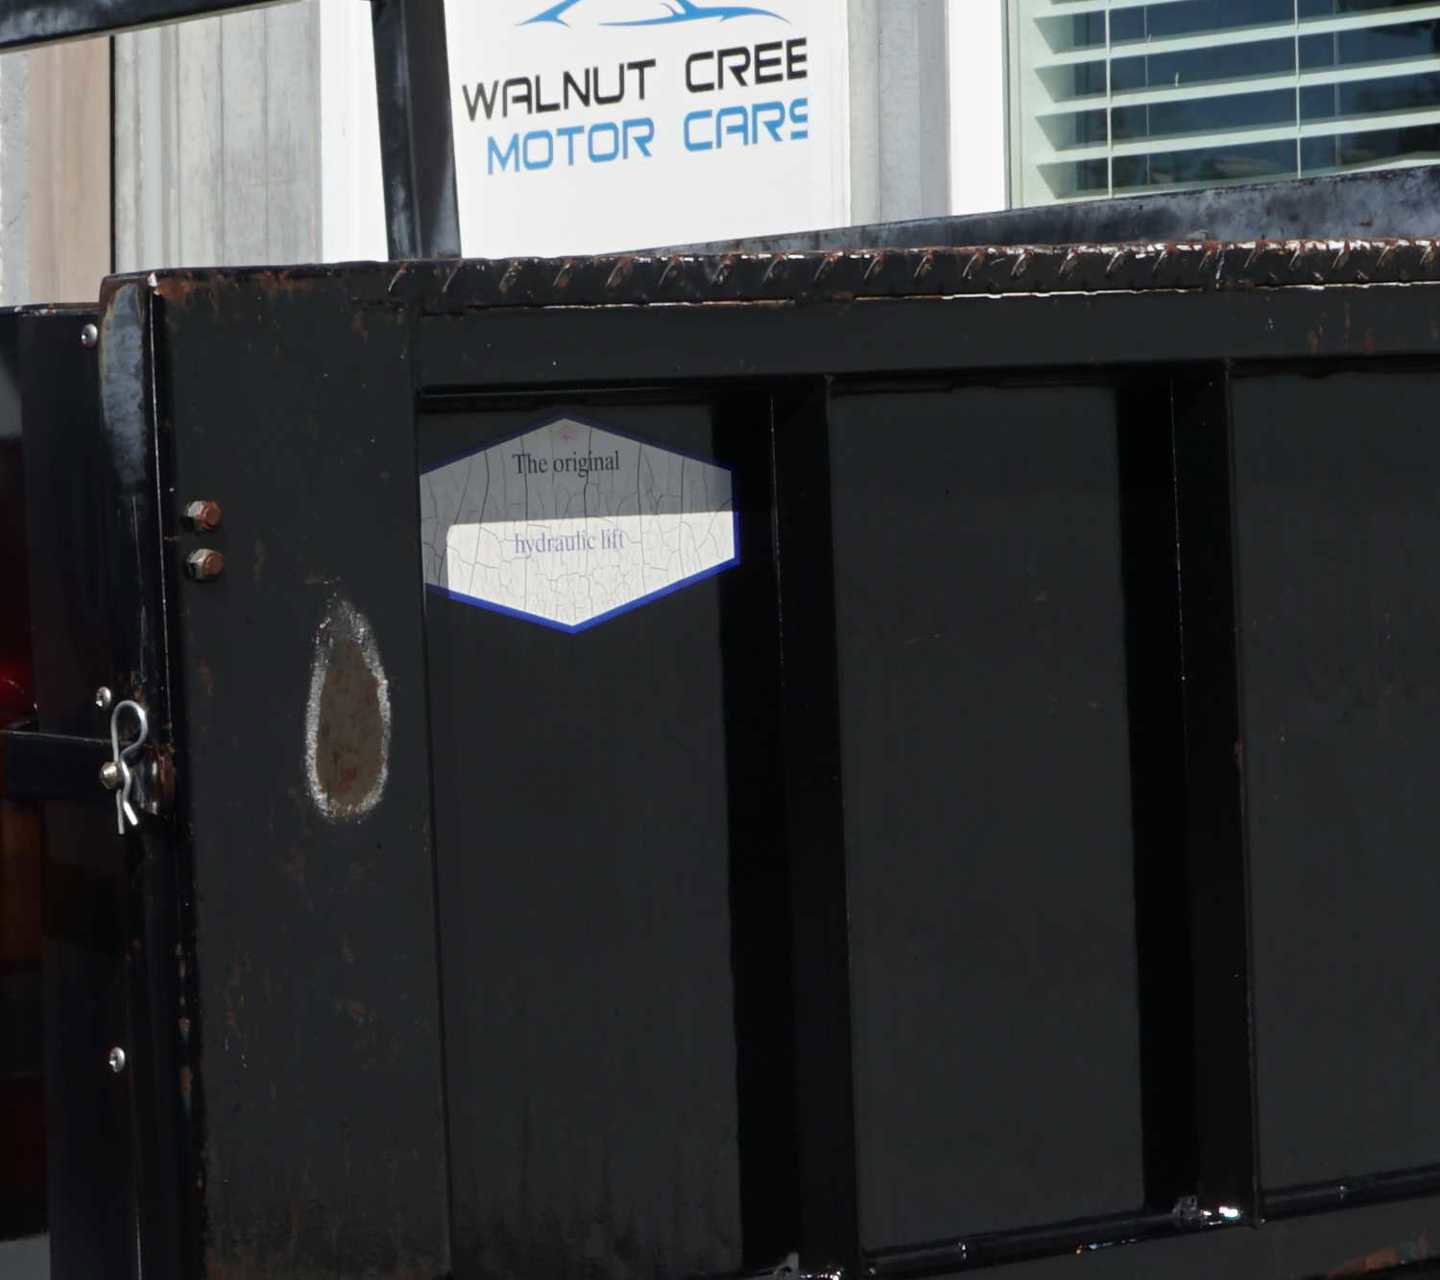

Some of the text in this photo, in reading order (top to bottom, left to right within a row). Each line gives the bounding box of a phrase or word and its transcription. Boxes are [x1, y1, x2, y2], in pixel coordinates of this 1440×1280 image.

[462, 58, 657, 122] WALNUT
[487, 97, 809, 176] MOTOR CARS
[512, 450, 621, 478] The original
[514, 527, 626, 555] hydraulic lift
